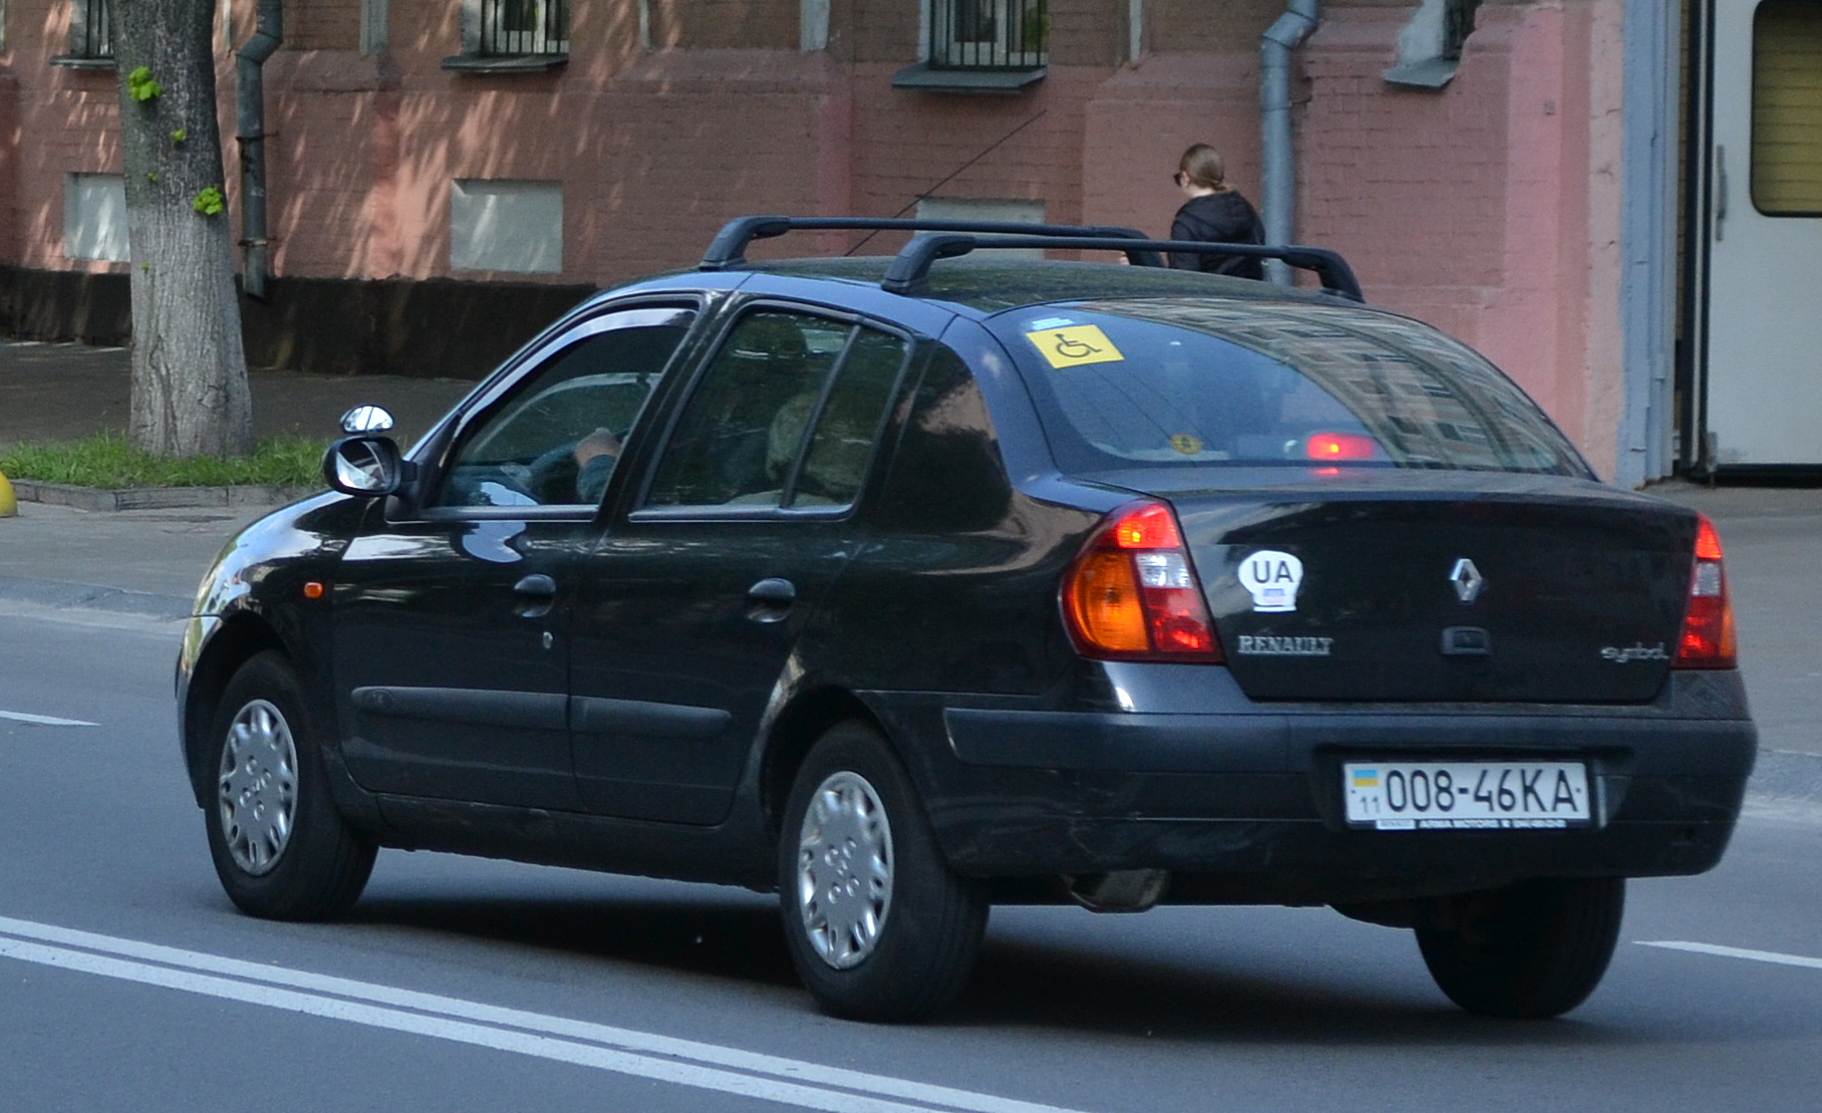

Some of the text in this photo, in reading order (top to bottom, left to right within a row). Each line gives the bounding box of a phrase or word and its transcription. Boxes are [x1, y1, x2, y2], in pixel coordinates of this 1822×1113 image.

[1252, 560, 1294, 584] UA
[1238, 635, 1333, 655] RENAULT
[1385, 769, 1578, 813] 008-46KA
